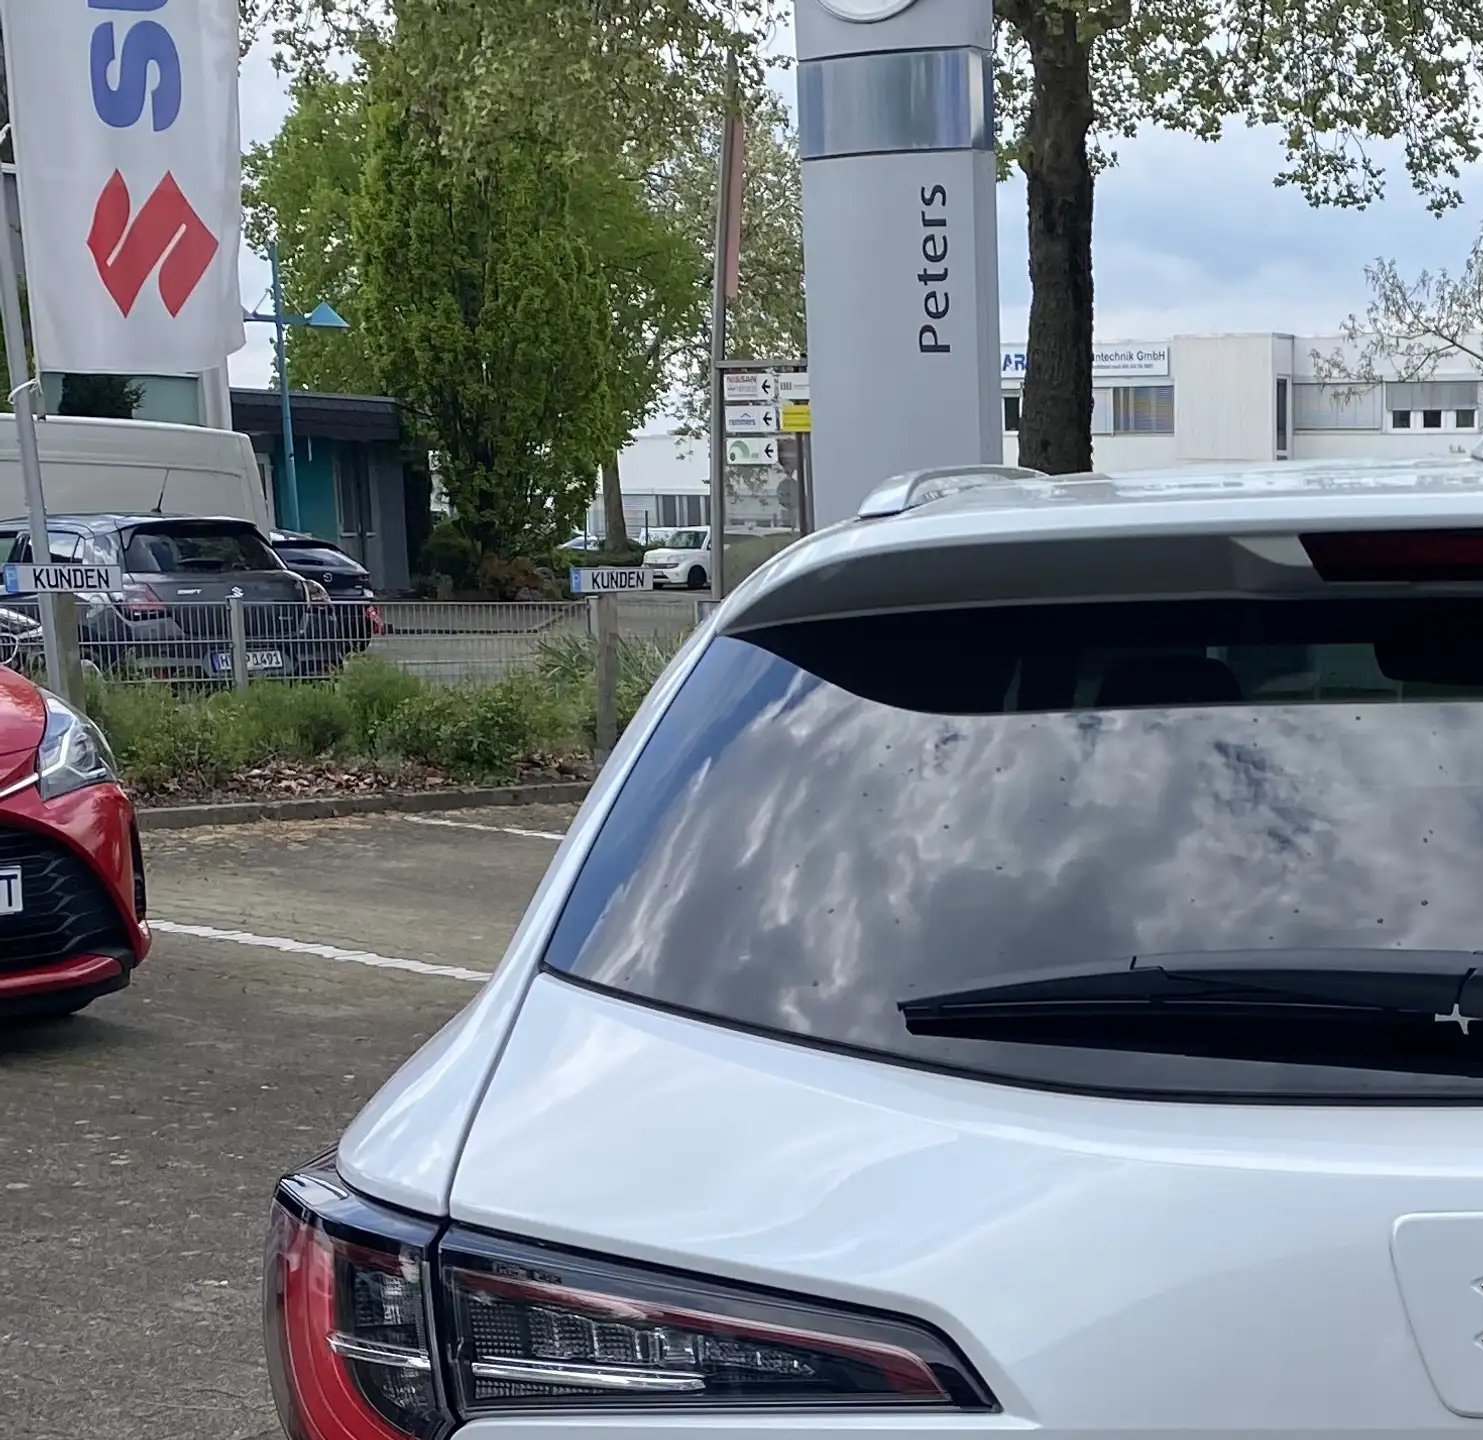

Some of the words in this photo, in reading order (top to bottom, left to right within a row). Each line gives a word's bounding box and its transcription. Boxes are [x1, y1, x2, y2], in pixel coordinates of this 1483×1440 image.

[88, 0, 182, 132] S
[917, 184, 951, 353] Peters
[1136, 351, 1166, 361] GmbH
[33, 568, 110, 589] KUNDEN
[591, 571, 645, 589] KUNDEN
